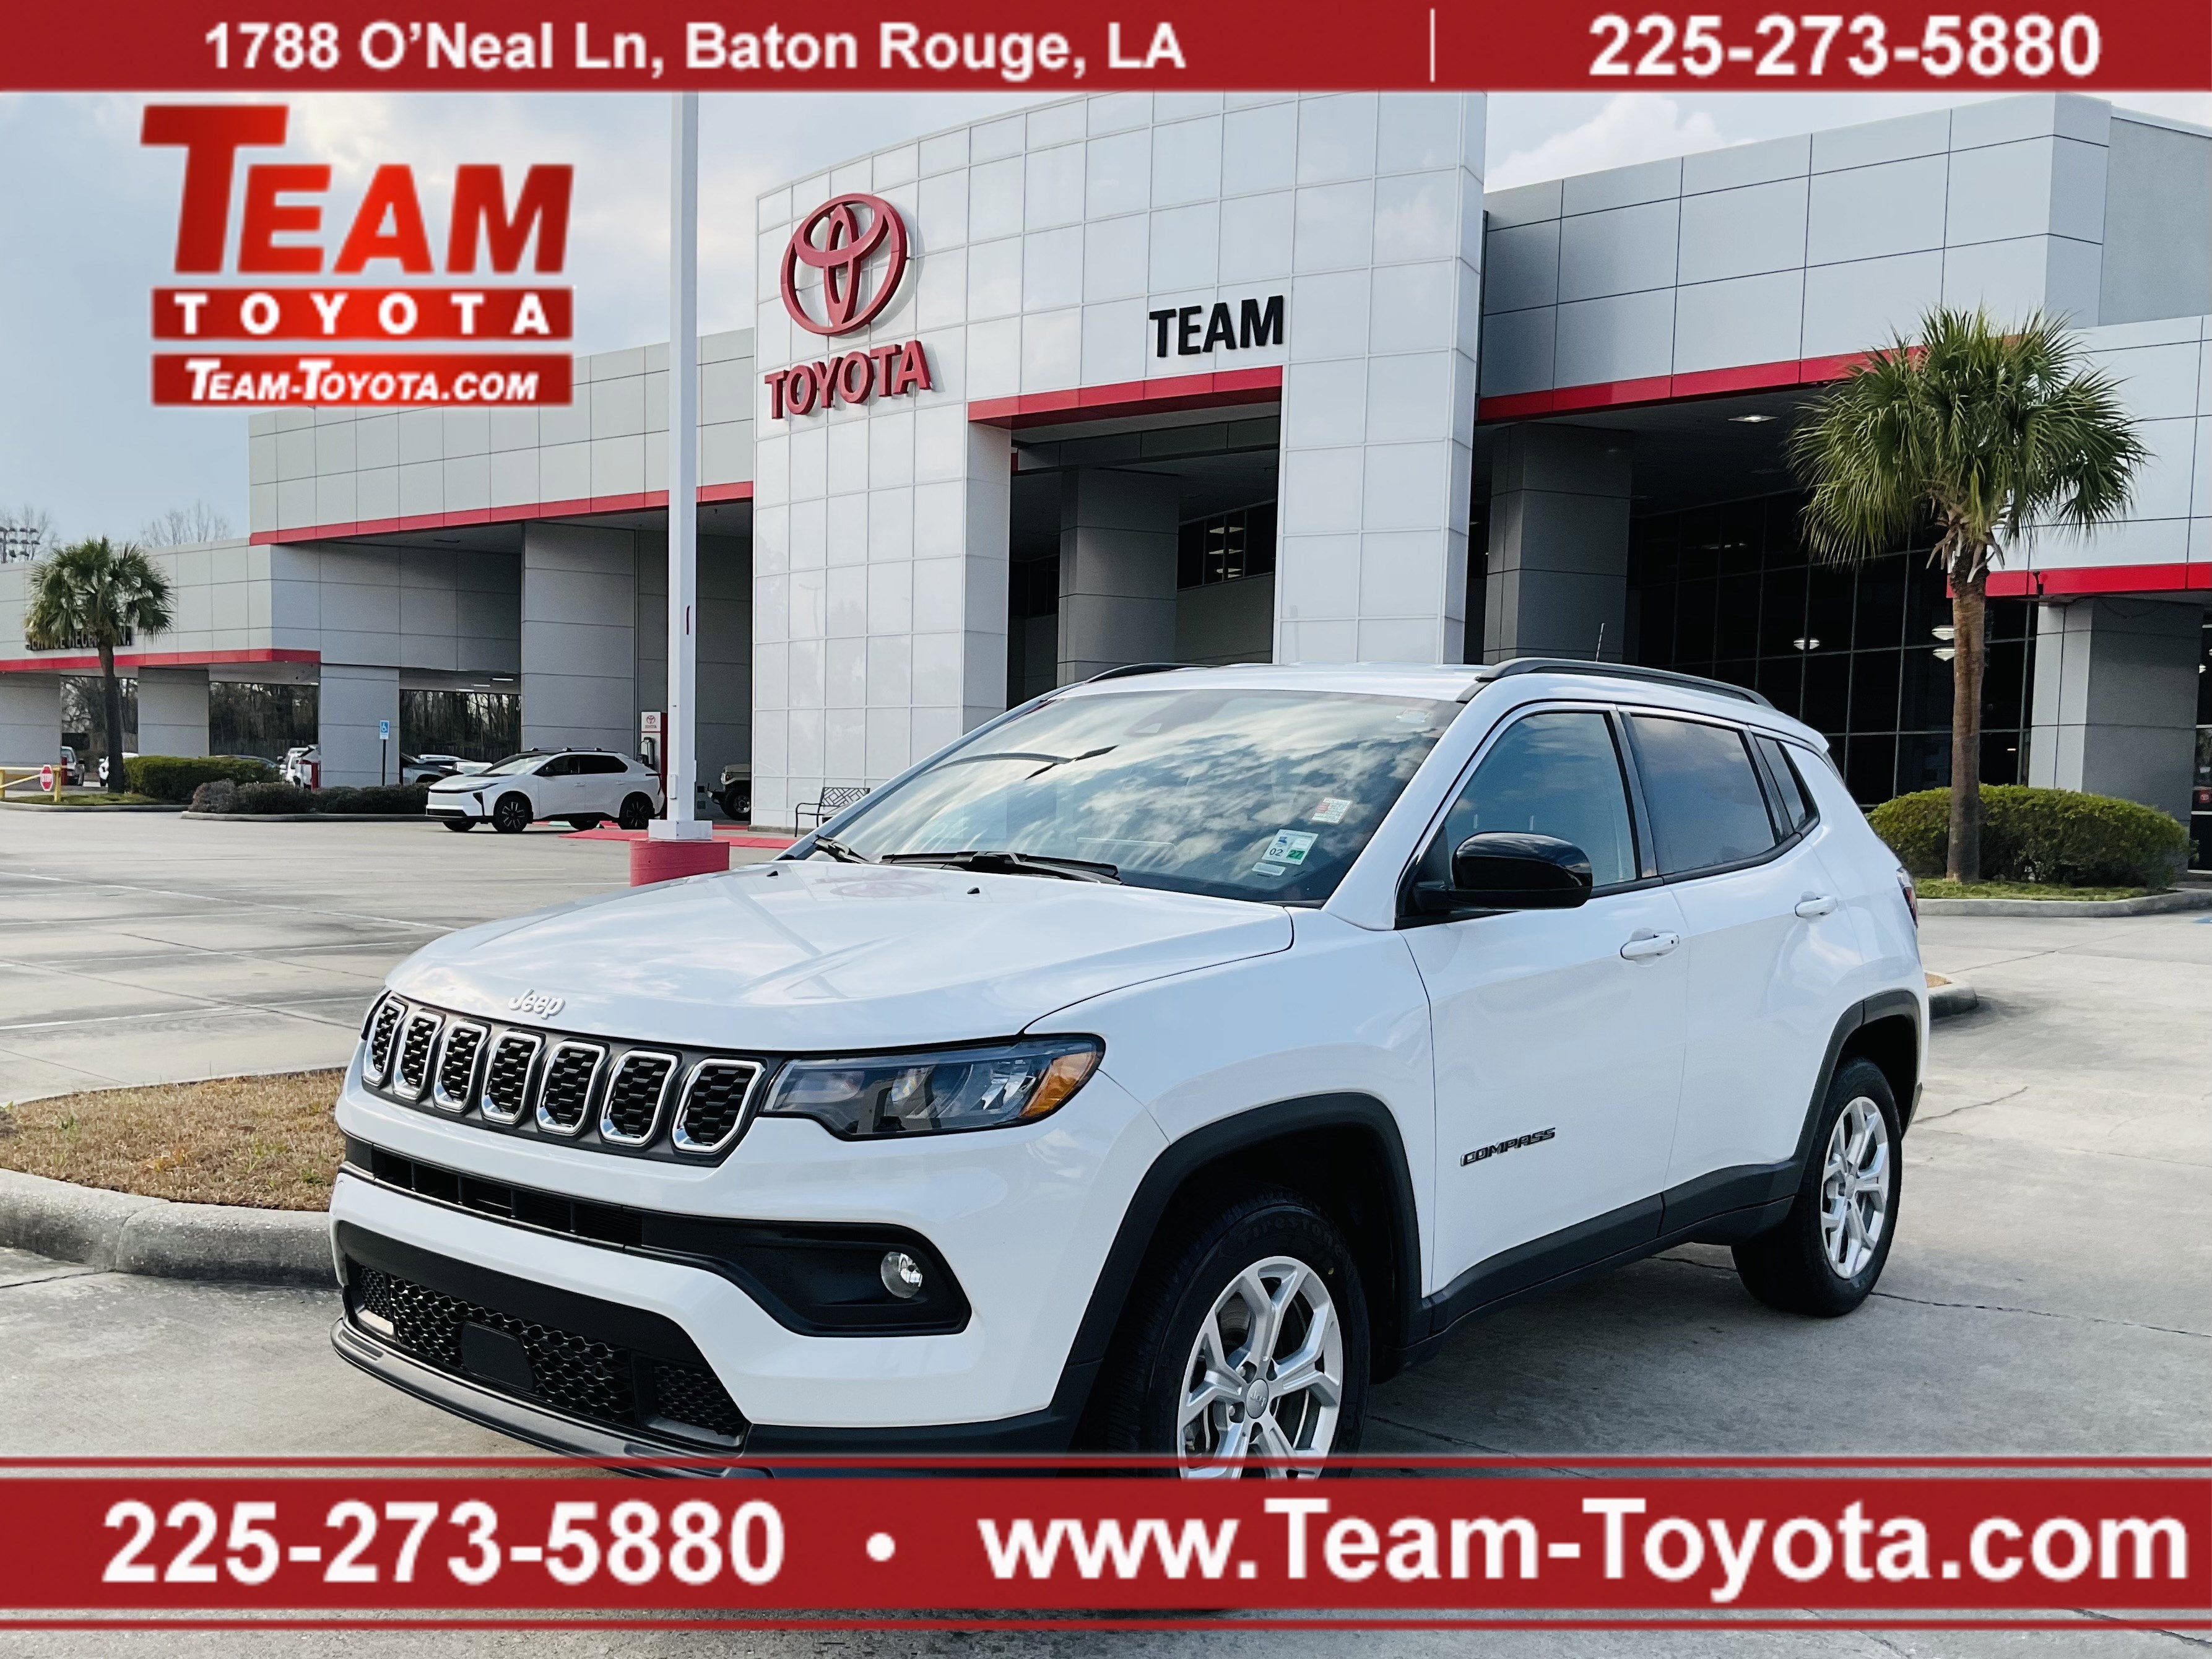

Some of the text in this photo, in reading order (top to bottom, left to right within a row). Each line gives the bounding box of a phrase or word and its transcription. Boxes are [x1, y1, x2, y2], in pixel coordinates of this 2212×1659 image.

[1149, 295, 1283, 358] TEAM
[765, 340, 932, 419] TOYOTA
[1269, 847, 1283, 857] 02
[1287, 849, 1304, 859] 27
[508, 988, 566, 1020] Jeep
[1460, 1126, 1556, 1167] COMPASS
